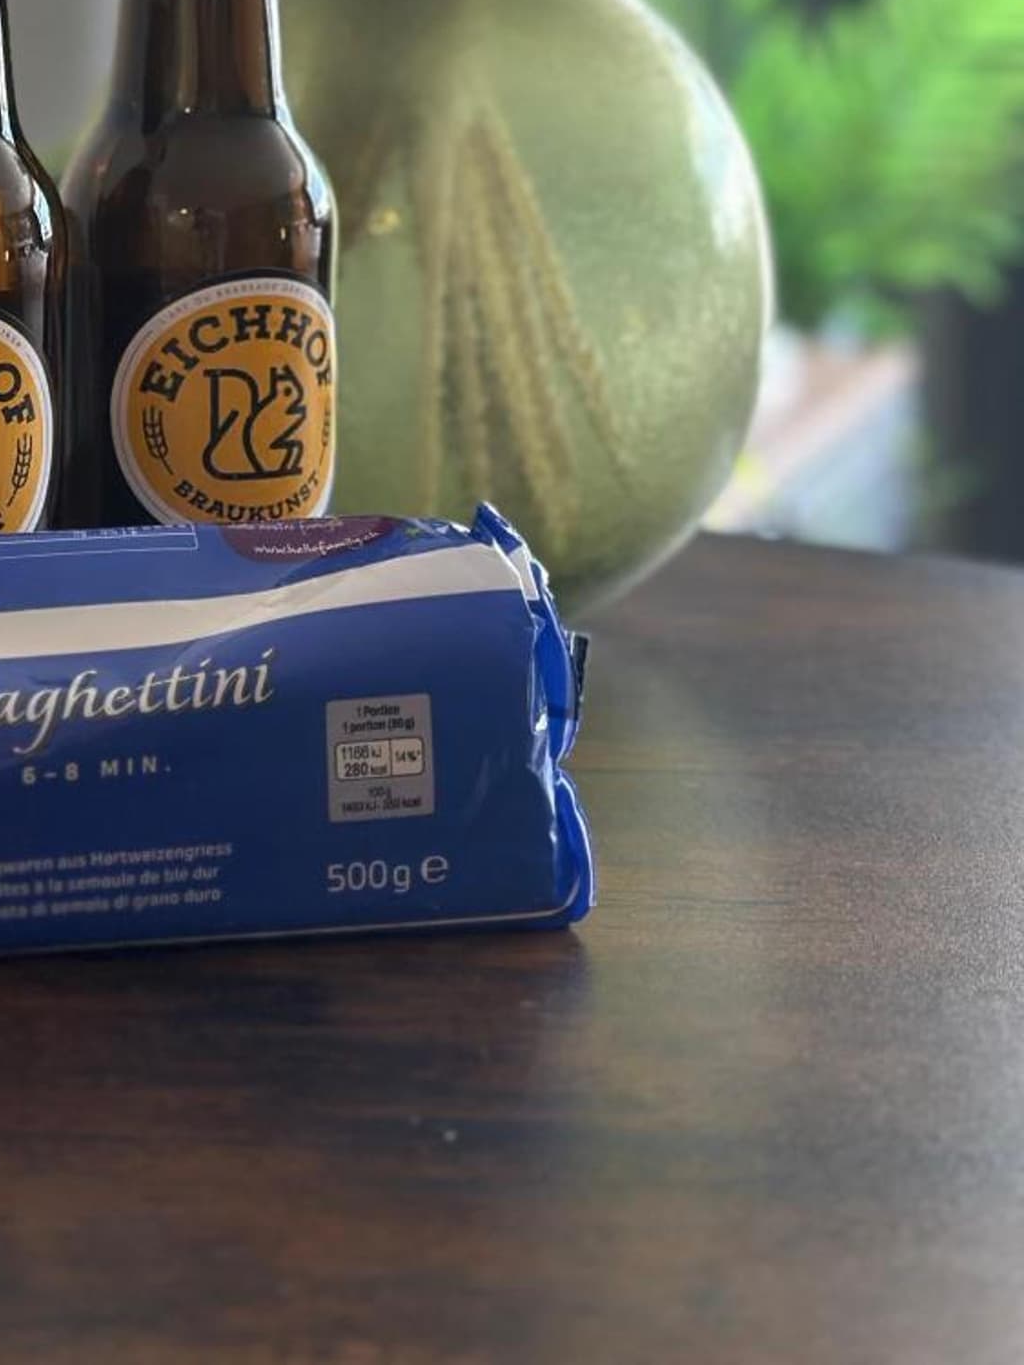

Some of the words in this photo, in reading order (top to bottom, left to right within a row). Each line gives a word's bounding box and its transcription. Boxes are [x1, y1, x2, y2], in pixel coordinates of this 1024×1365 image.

[140, 304, 331, 402] EICHHOF
[174, 469, 320, 521] BRAUKUNST
[363, 705, 401, 717] Portion
[100, 756, 172, 777] MIN.
[344, 762, 369, 777] 280
[58, 855, 86, 871] aus
[89, 842, 233, 867] Hartweizengriess
[49, 878, 63, 893] la
[68, 872, 136, 892] semoule
[140, 869, 160, 885] de
[191, 865, 220, 881] dur
[113, 894, 130, 910] di
[133, 890, 179, 912] grano
[182, 887, 222, 904] duro
